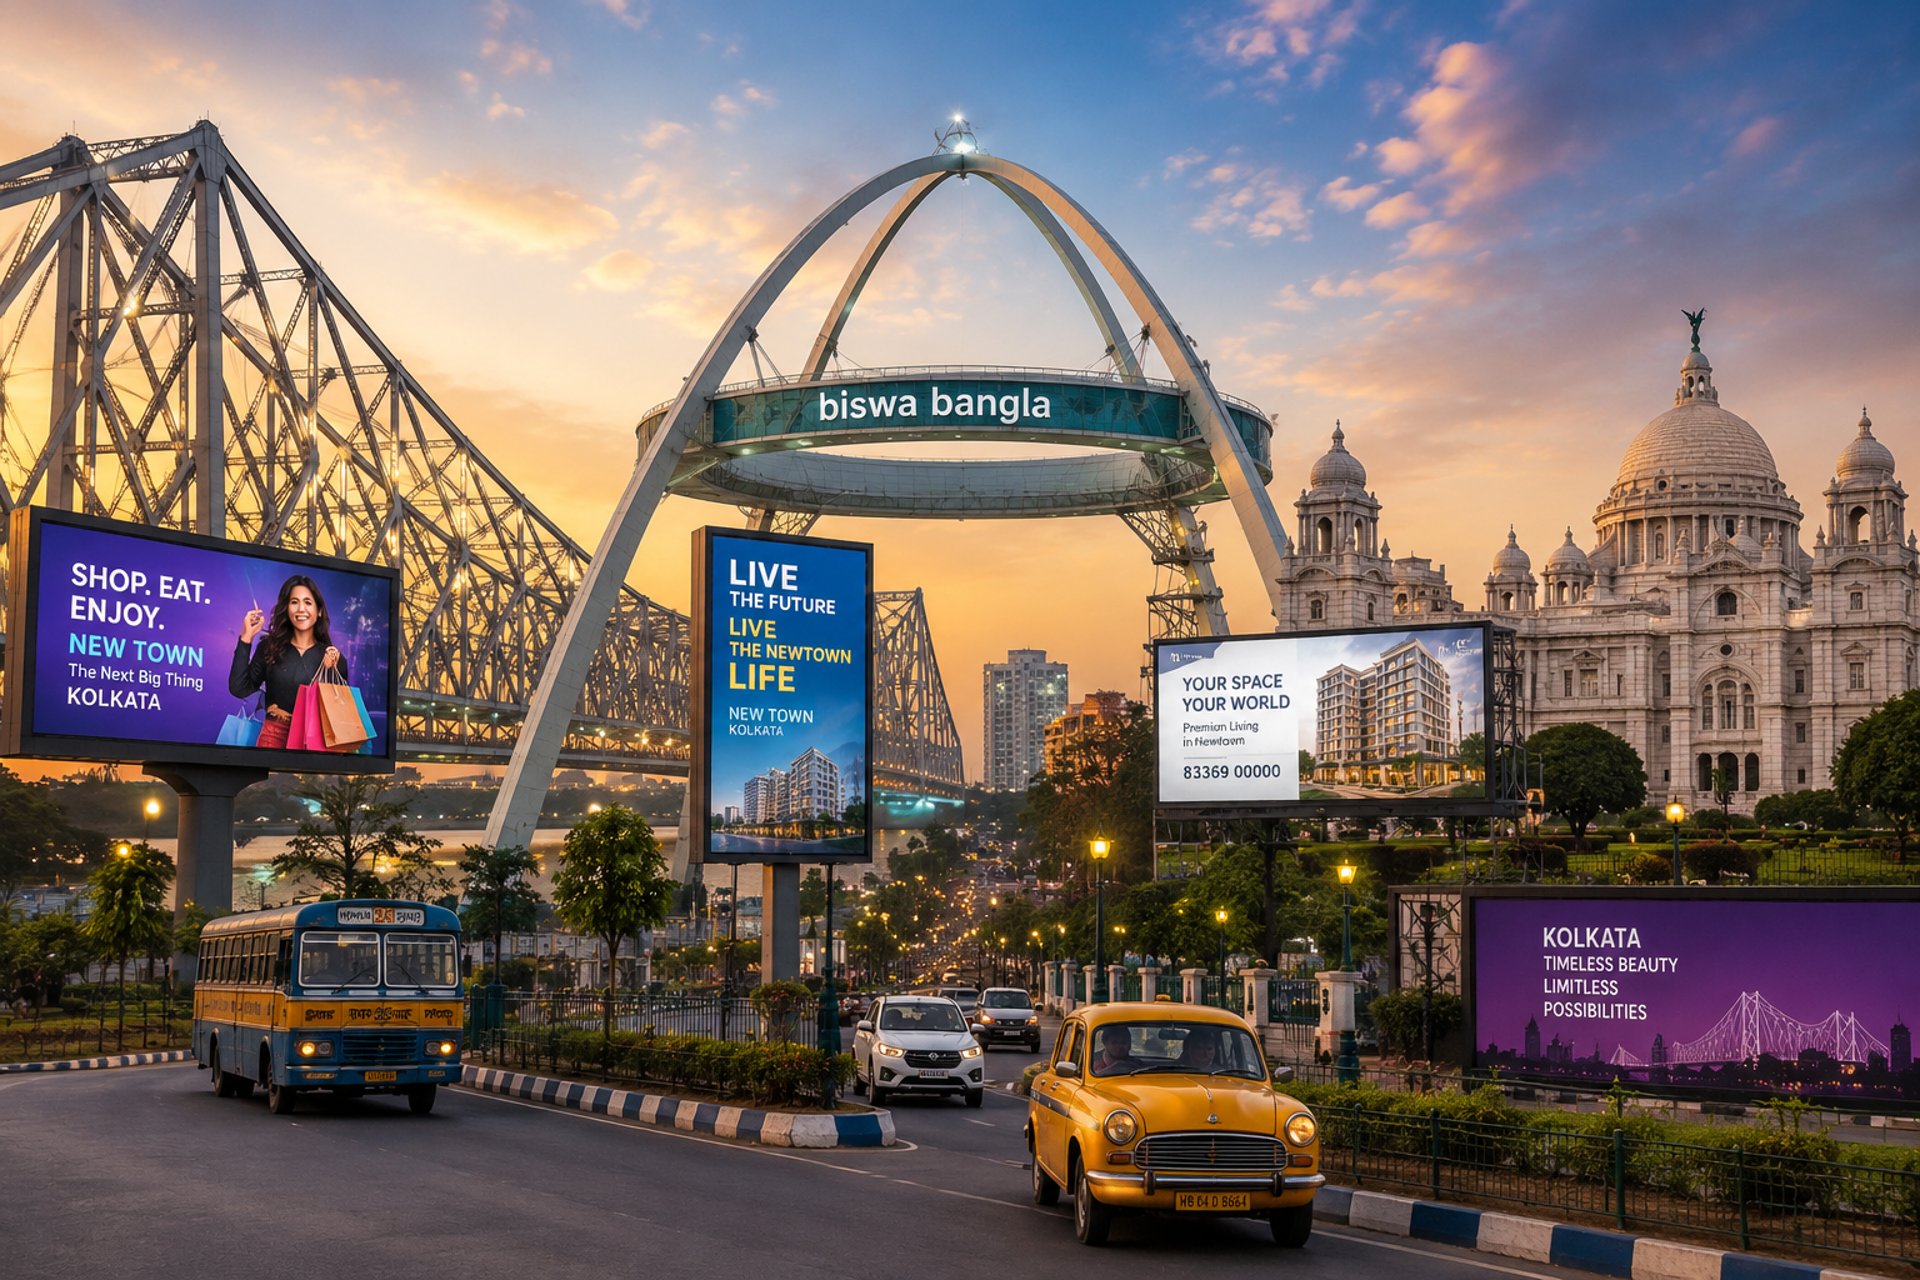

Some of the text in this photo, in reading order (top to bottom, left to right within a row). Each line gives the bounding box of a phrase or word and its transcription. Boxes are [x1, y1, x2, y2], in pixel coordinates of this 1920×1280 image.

[819, 386, 1051, 425] biswa bangla
[71, 562, 211, 605] SHOP. EAT.
[729, 558, 798, 591] LIVE
[70, 594, 165, 630] ENJOY.
[729, 590, 836, 615] THE FUTURE
[729, 616, 777, 639] LIVE
[69, 632, 204, 668] NEW TOWN
[729, 640, 852, 664] THE NEWTOWN
[68, 662, 204, 692] The Next Big Thing
[729, 661, 796, 692] LIFE
[1182, 673, 1283, 692] YOUR SPACE
[67, 686, 162, 711] KOLKATA
[1182, 694, 1291, 712] YOUR WORLD
[729, 706, 814, 724] NEW TOWN
[1229, 720, 1259, 733] Living
[729, 724, 784, 736] KOLKATA
[1183, 736, 1193, 747] in
[1183, 763, 1281, 780] 83369 00000
[1543, 926, 1642, 949] KOLKATA
[1543, 955, 1679, 973] TIMELESS BEAUTY
[1543, 978, 1619, 996] LIMITLESS
[1543, 1001, 1647, 1021] POSSIBILITIES
